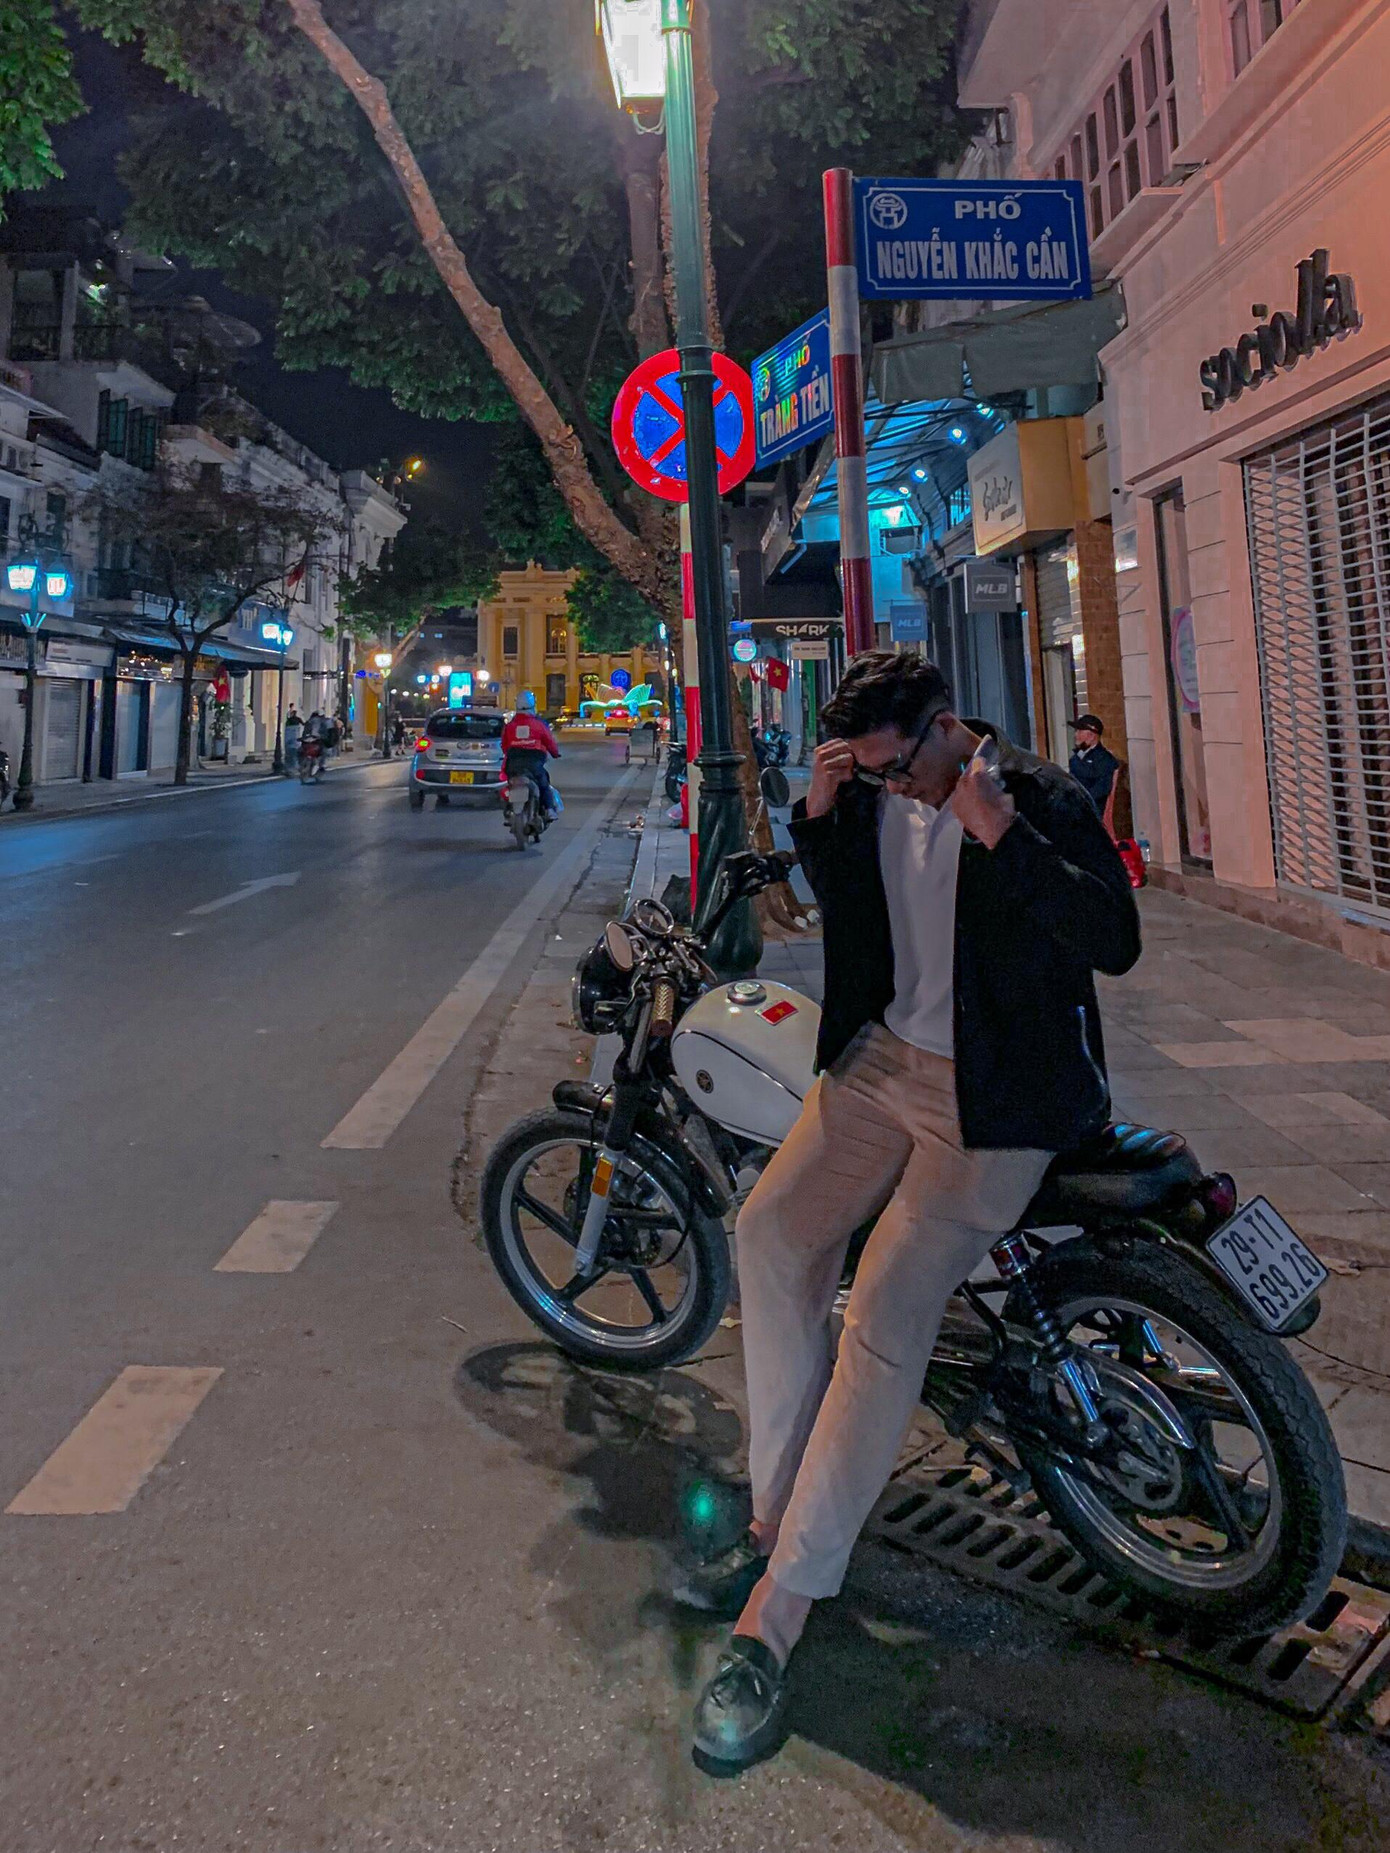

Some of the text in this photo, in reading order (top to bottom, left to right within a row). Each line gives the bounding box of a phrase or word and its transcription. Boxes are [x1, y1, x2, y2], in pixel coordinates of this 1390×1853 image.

[955, 193, 1022, 219] PHỐ
[876, 226, 1069, 279] NGUYỄN KHẮC CẦN
[1200, 248, 1364, 413] sociolla
[784, 333, 811, 377] PHỐ
[760, 364, 830, 448] TRÀNG TIỀN
[975, 583, 1008, 595] MLB
[897, 618, 922, 628] MLB
